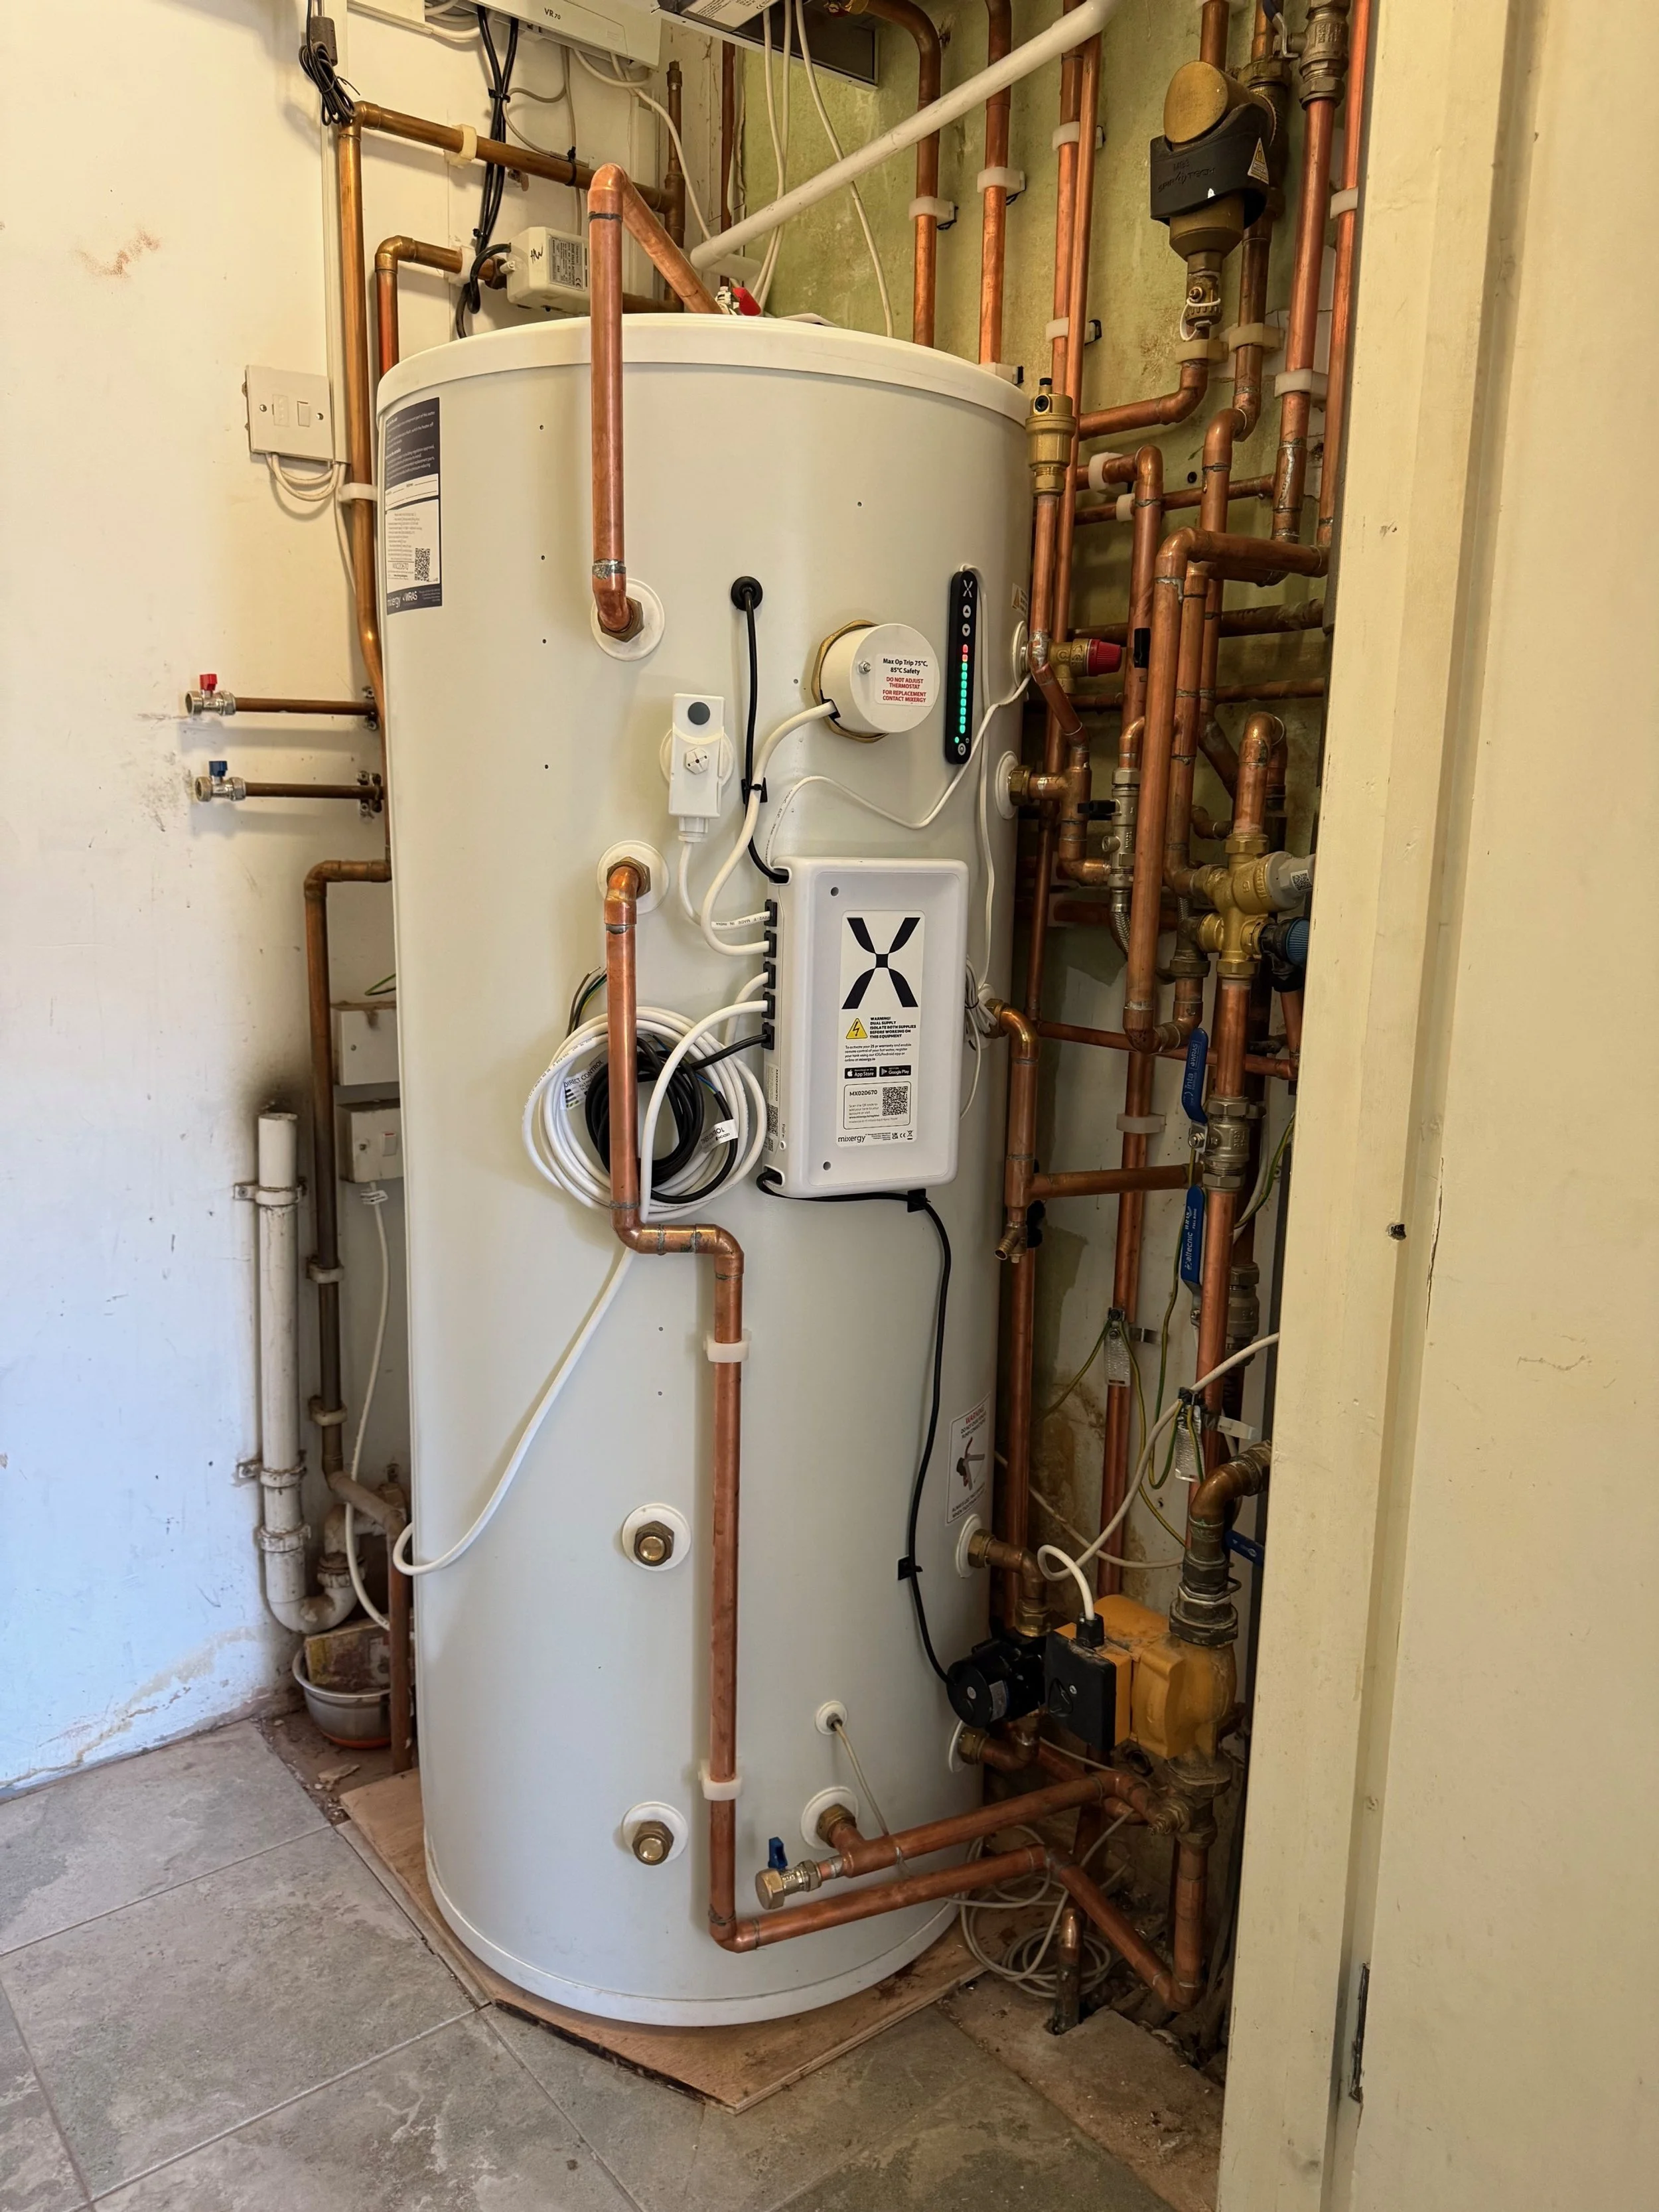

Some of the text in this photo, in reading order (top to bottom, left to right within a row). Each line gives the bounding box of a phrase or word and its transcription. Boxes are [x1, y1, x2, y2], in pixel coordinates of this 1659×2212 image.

[544, 7, 553, 17] VR
[563, 1078, 581, 1088] DIRECT
[581, 1061, 603, 1080] CONTROL
